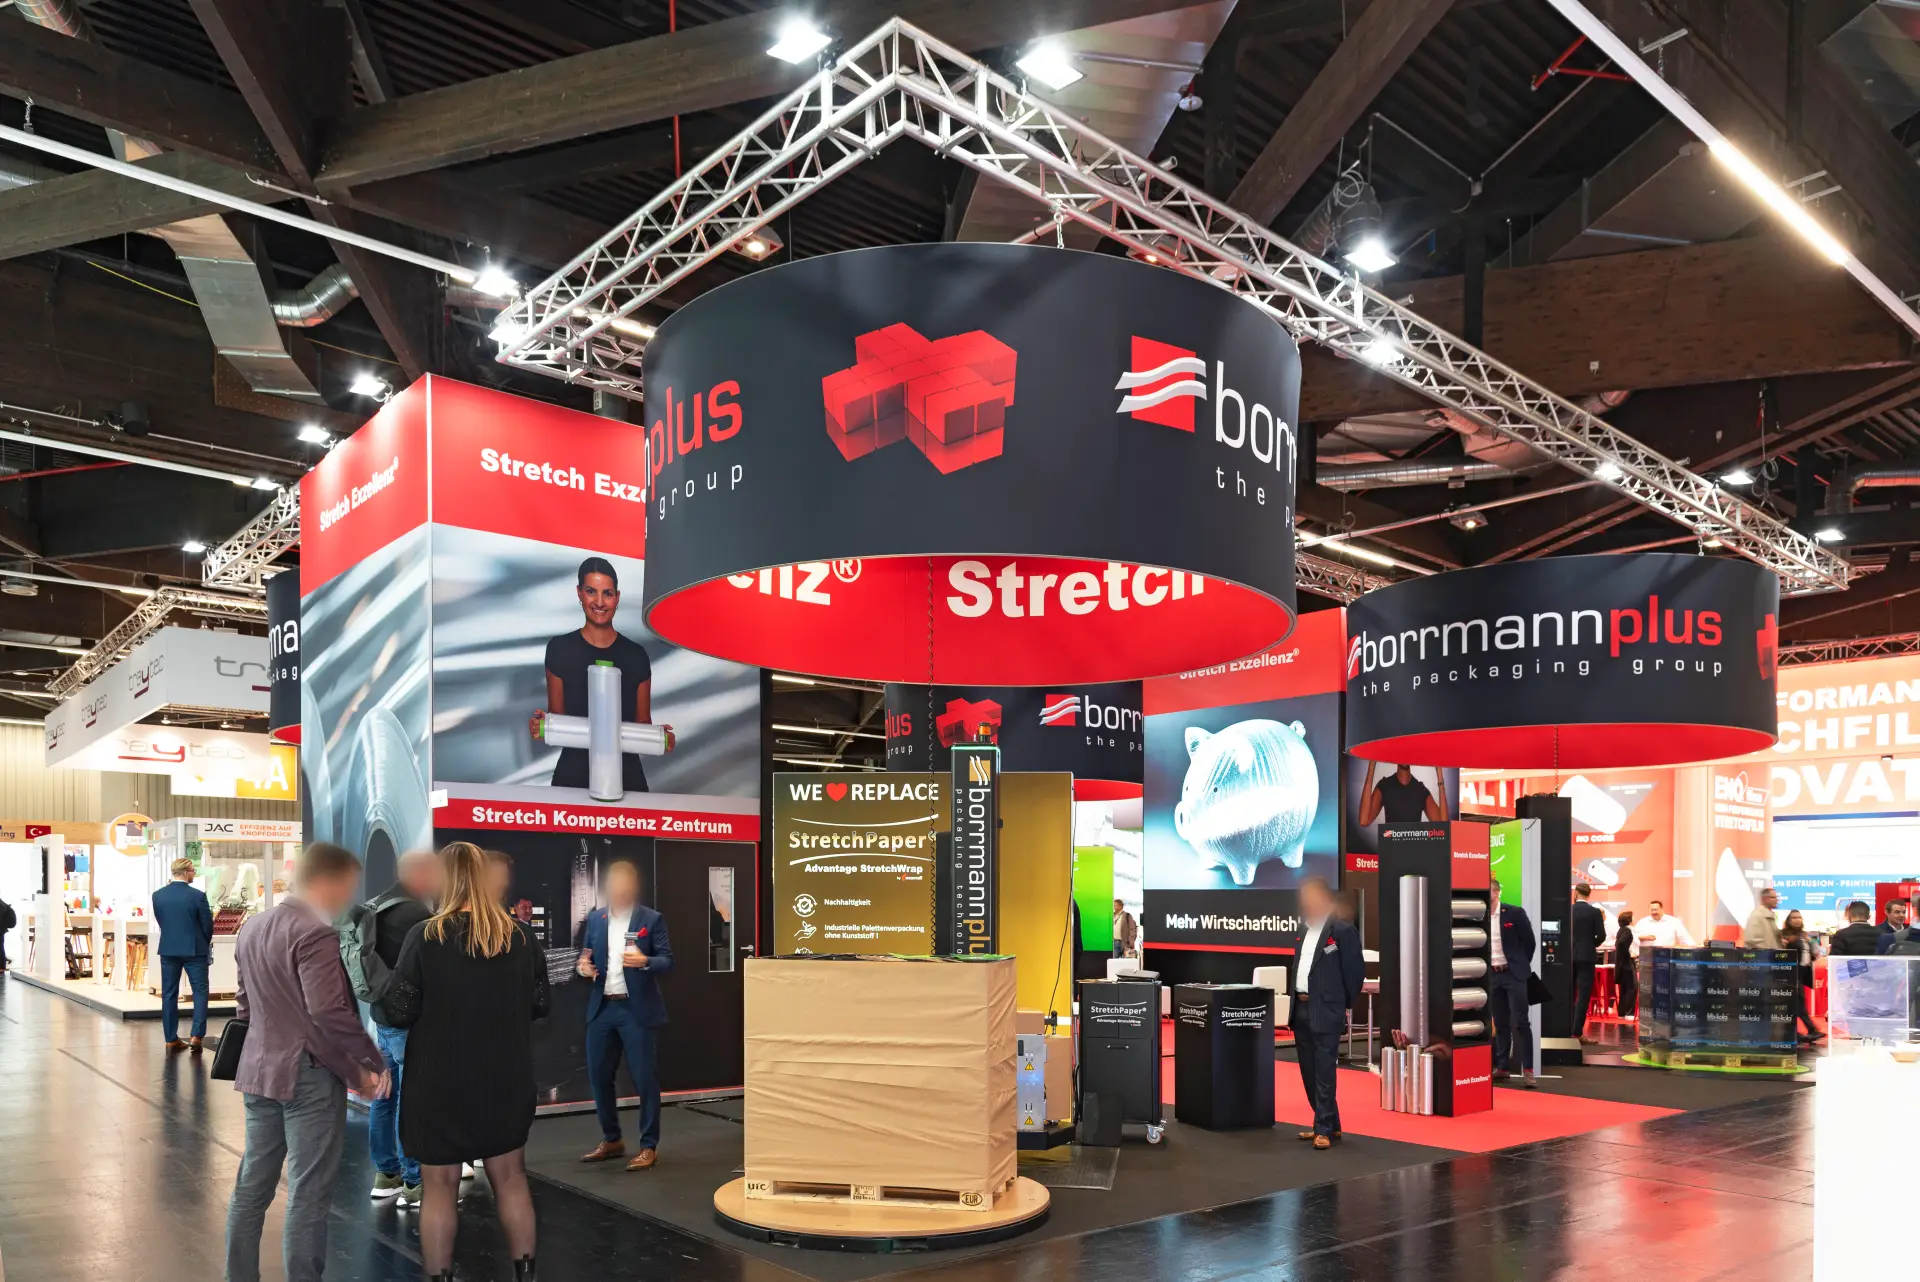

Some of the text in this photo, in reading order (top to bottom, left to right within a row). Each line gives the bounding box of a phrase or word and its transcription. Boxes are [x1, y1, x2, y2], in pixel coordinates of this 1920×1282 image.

[480, 447, 586, 491] Stretch
[659, 464, 743, 520] group
[1215, 466, 1266, 506] the
[320, 494, 351, 532] Stretch
[1362, 595, 1722, 675] borrmannplus
[1229, 647, 1300, 673] Exzellenz®
[1363, 658, 1722, 697] the packaging group
[1086, 735, 1115, 747] the
[790, 783, 939, 801] WE REPLACE
[204, 823, 234, 832] JAC
[472, 806, 733, 834] Stretch Kompetenz Zentrum
[955, 788, 965, 869] packaging
[1392, 828, 1445, 838] borrmannplus
[805, 864, 923, 875] Advantage StretchWrap
[963, 788, 991, 957] borrmannplu
[824, 898, 872, 907] Nachhaltigkeit
[824, 924, 925, 933] Industrielle Palettenverpackung
[1166, 913, 1198, 929] Mehr
[1221, 1010, 1267, 1019] StretchPaper®
[965, 1194, 979, 1204] EUR
